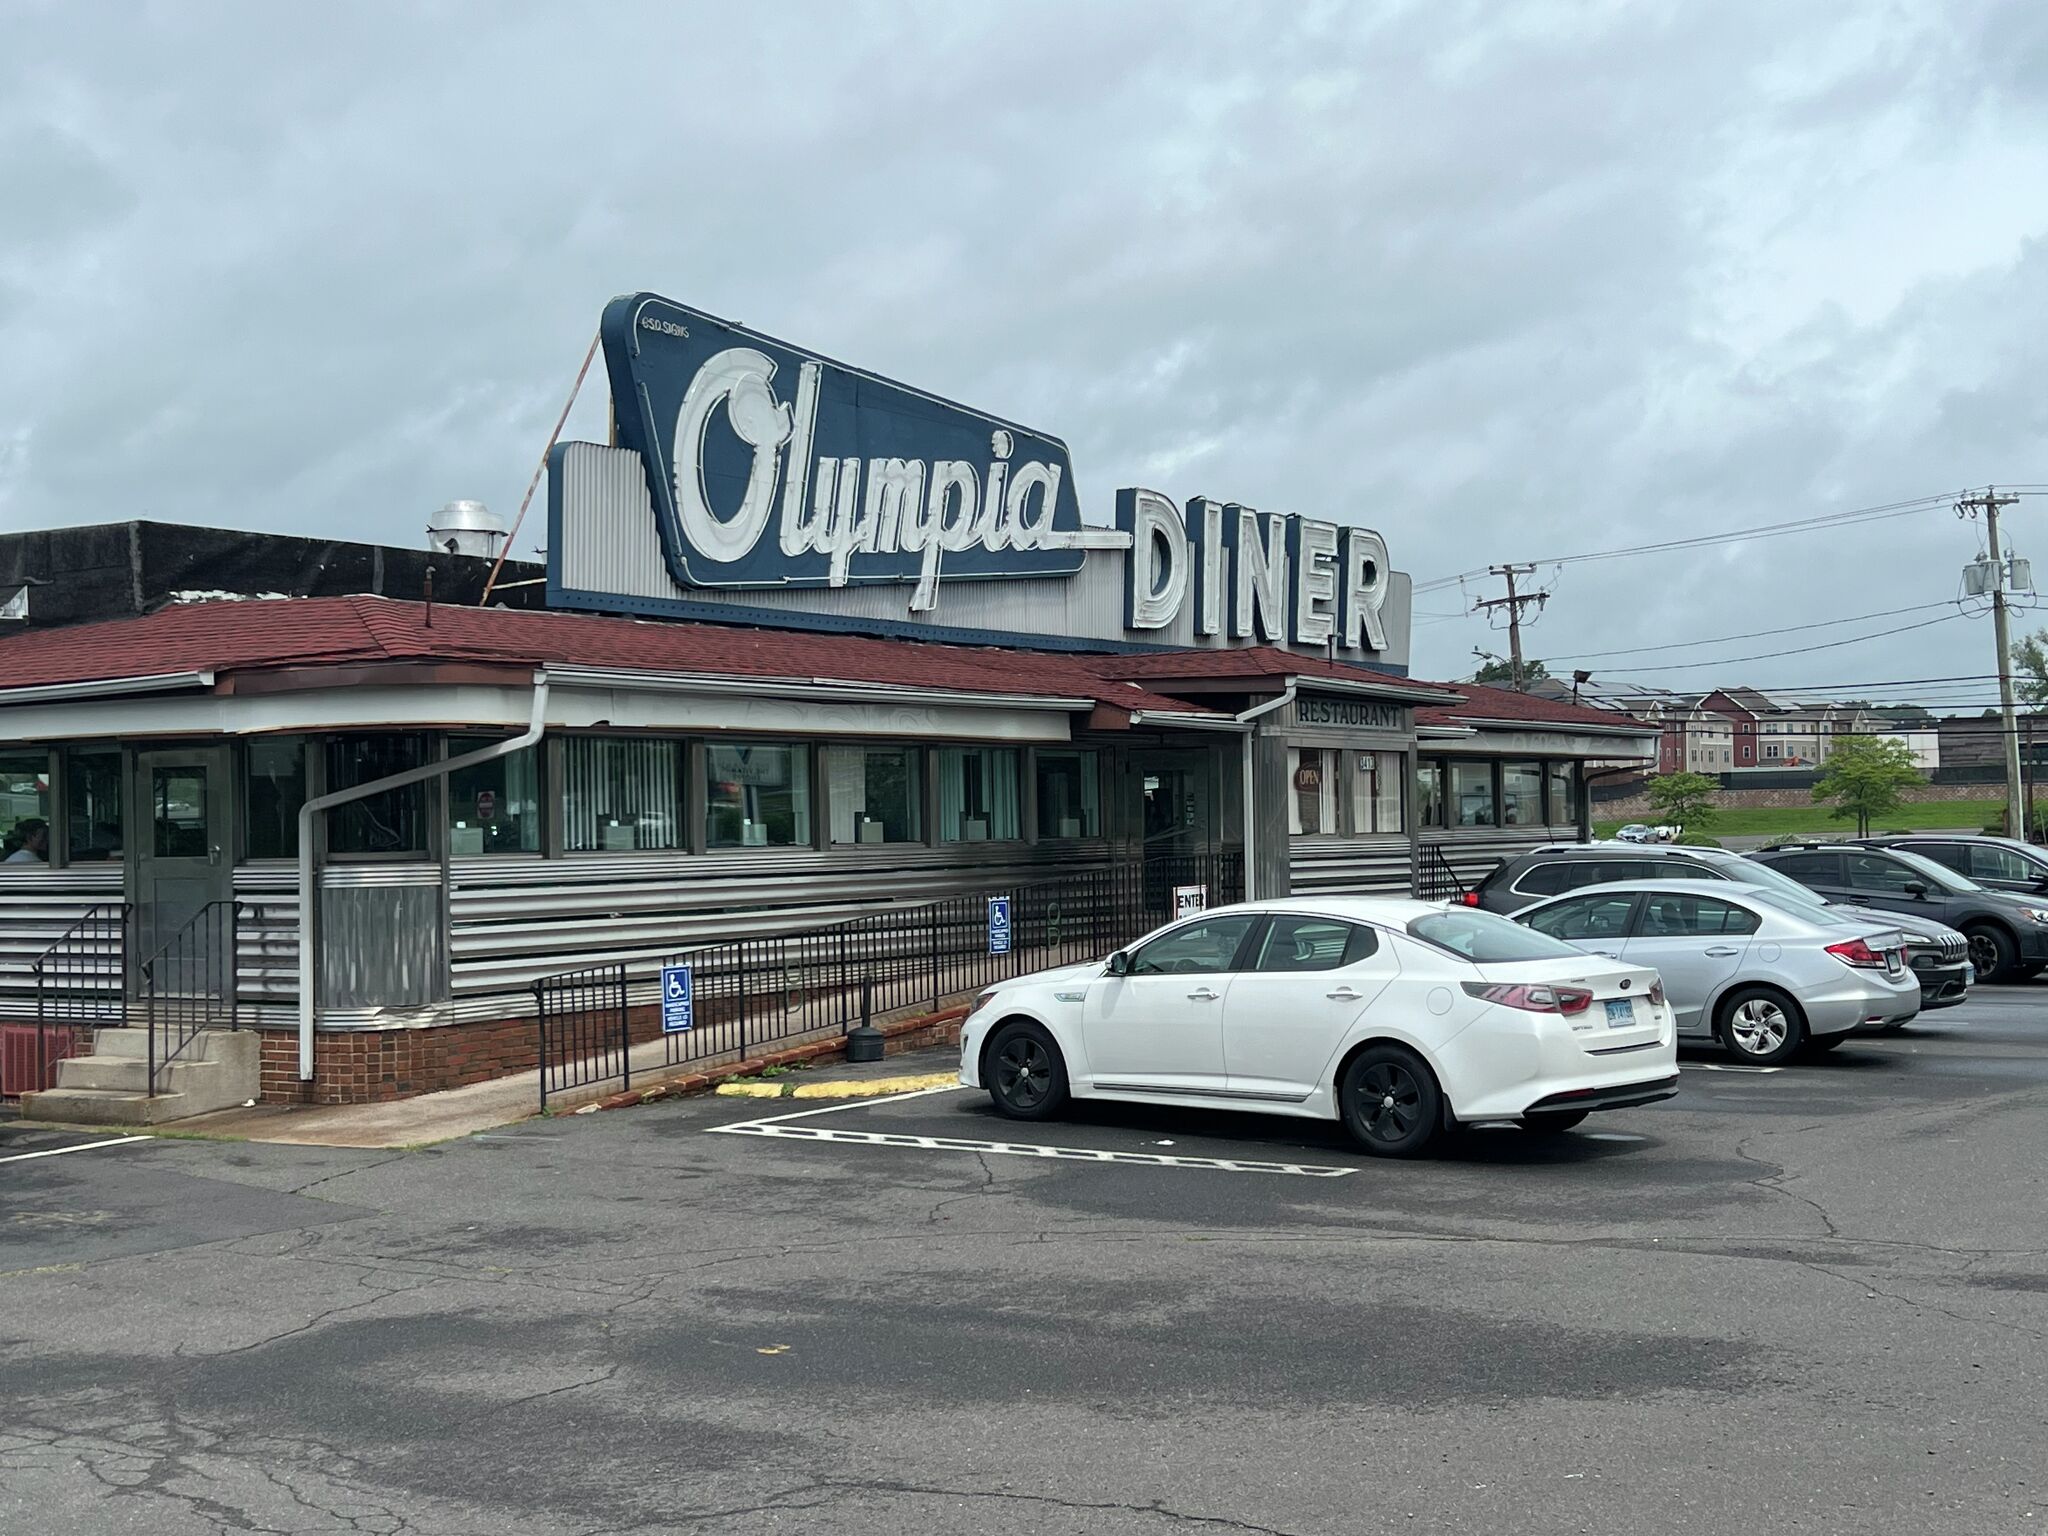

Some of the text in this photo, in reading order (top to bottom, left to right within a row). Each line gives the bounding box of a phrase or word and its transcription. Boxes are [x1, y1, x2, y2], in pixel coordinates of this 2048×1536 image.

[673, 347, 1390, 651] Olympia DINER
[1298, 699, 1400, 728] RESTAURANT
[1299, 769, 1319, 785] OPEN
[1176, 893, 1204, 908] ENTER
